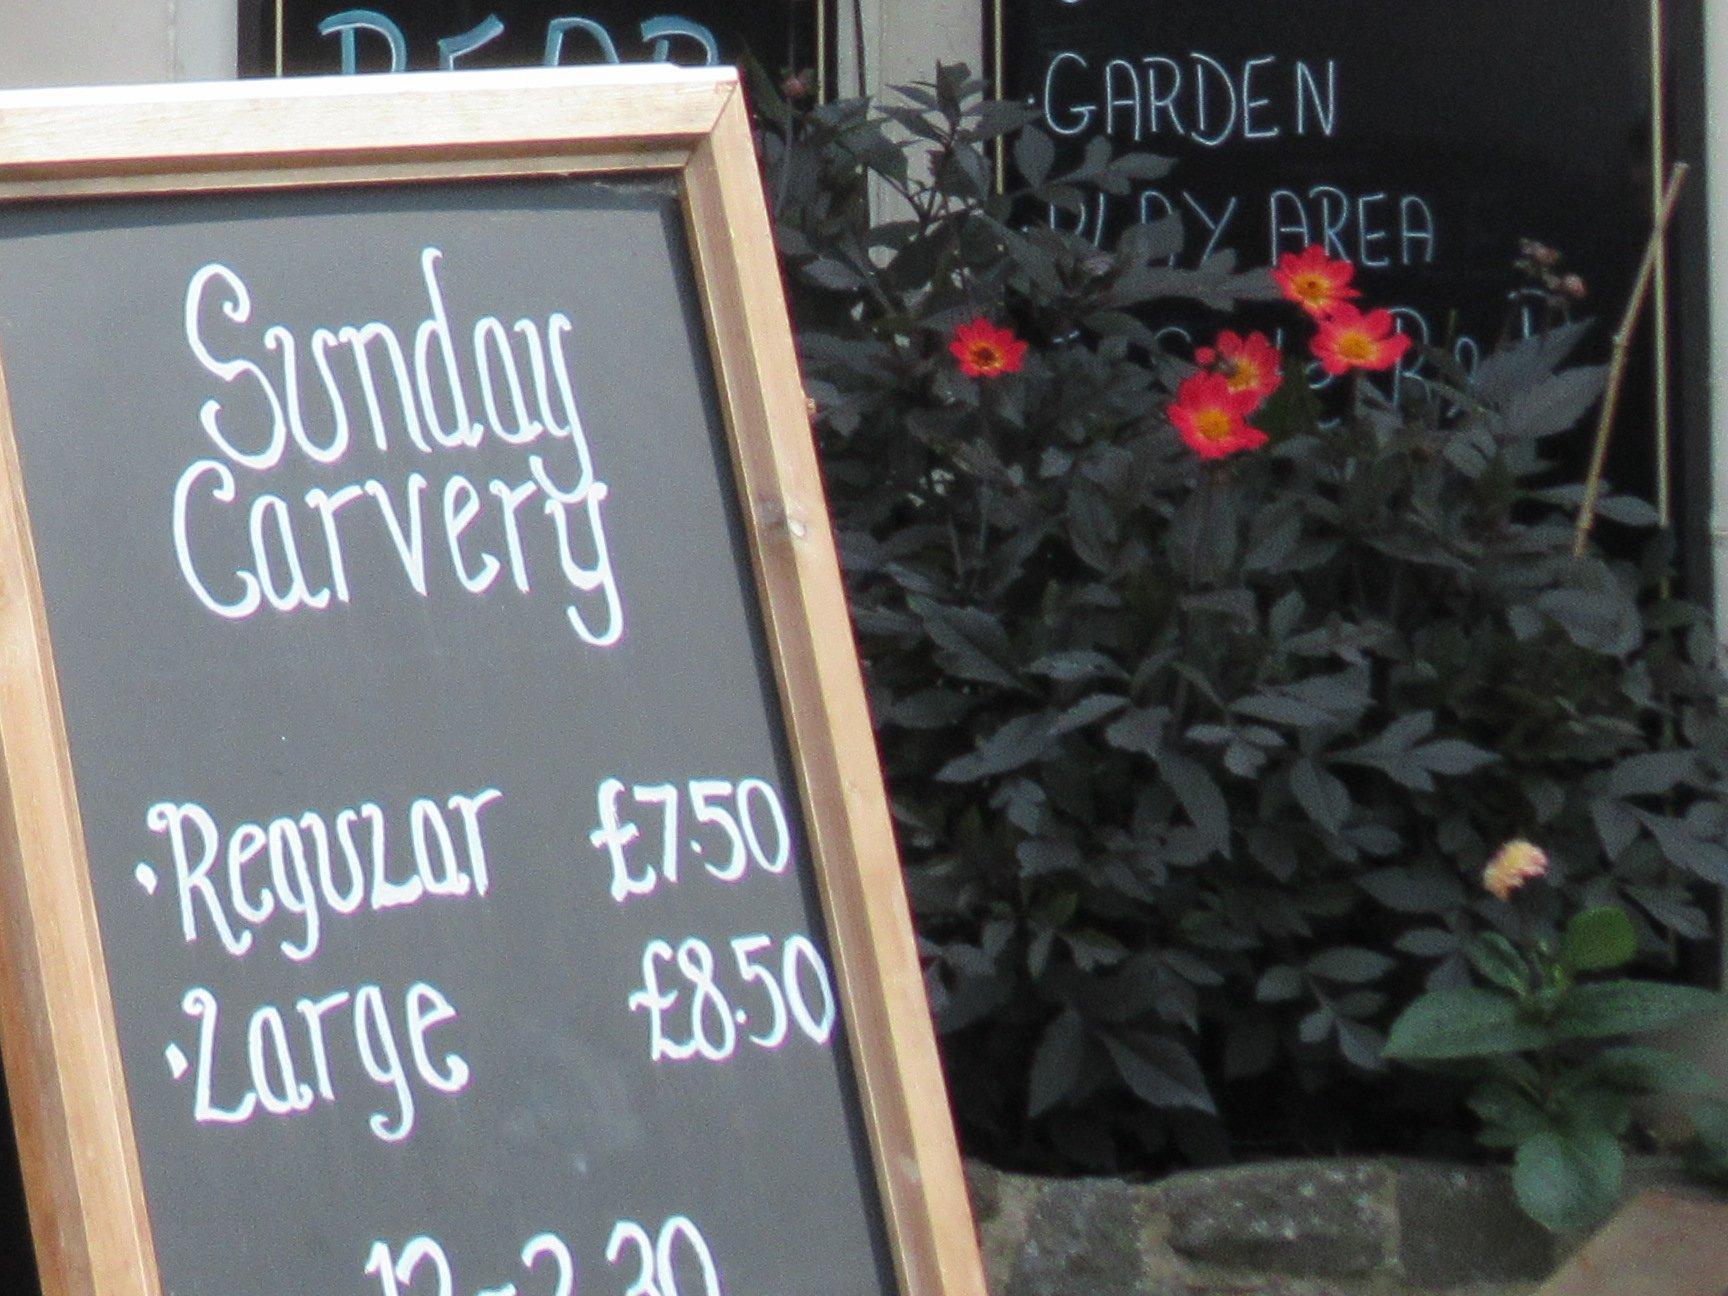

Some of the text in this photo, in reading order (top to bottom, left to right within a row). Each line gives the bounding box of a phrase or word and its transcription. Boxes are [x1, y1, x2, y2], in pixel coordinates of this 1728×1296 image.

[1044, 52, 1336, 146] GARDEN
[1269, 186, 1436, 268] AREA
[183, 247, 593, 500] Sunday
[172, 458, 625, 648] Carvery
[148, 776, 793, 962] Regular £7.50
[181, 931, 839, 1142] Large £8.50
